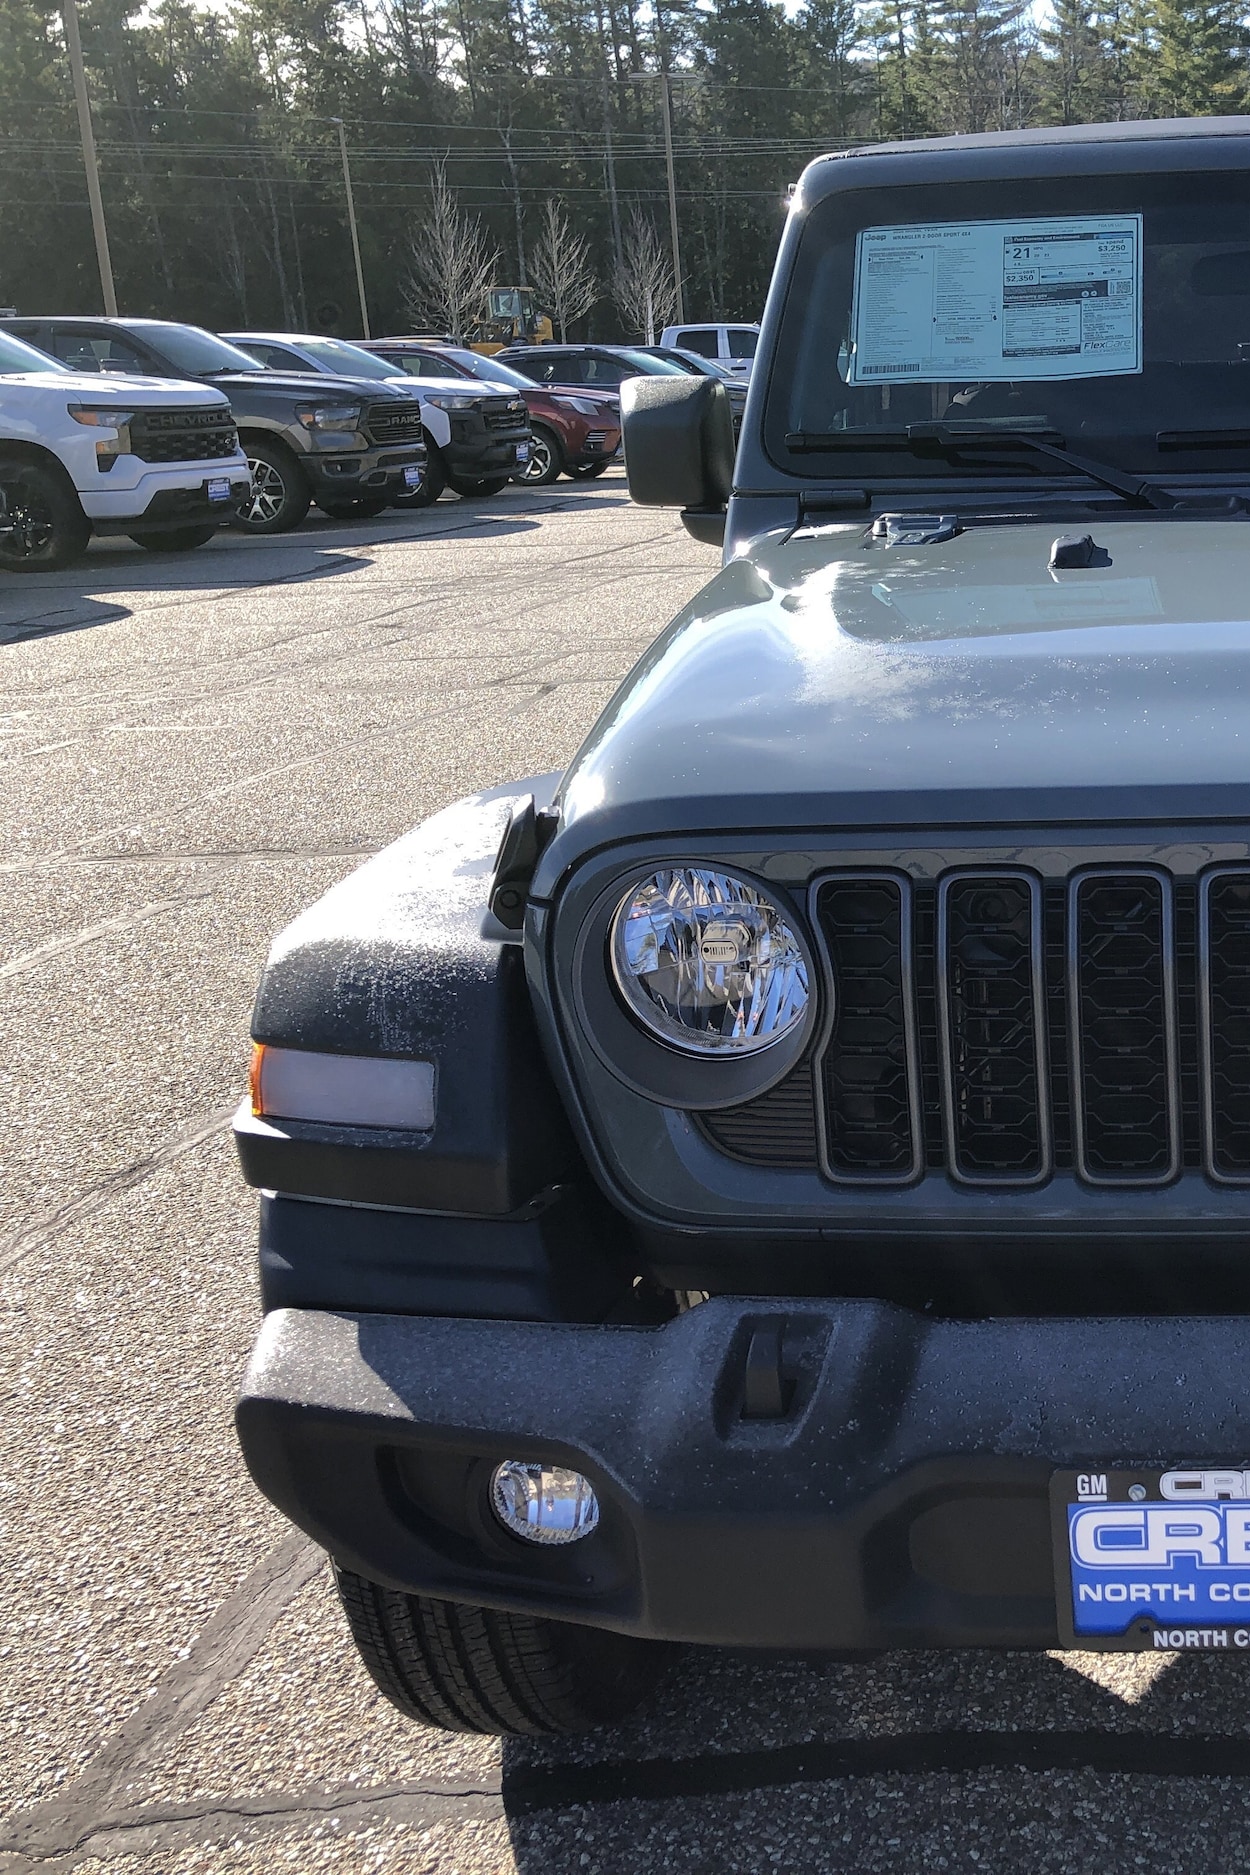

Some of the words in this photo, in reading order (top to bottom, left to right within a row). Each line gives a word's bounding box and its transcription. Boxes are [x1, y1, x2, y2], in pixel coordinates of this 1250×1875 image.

[1013, 247, 1030, 259] 21
[1098, 244, 1126, 253] $3,250
[1084, 340, 1131, 349] FlexCare
[147, 412, 233, 427] CHEVROLE
[1076, 1473, 1108, 1502] GM
[1078, 1582, 1196, 1602] NORTH
[1152, 1628, 1228, 1649] NORTH
